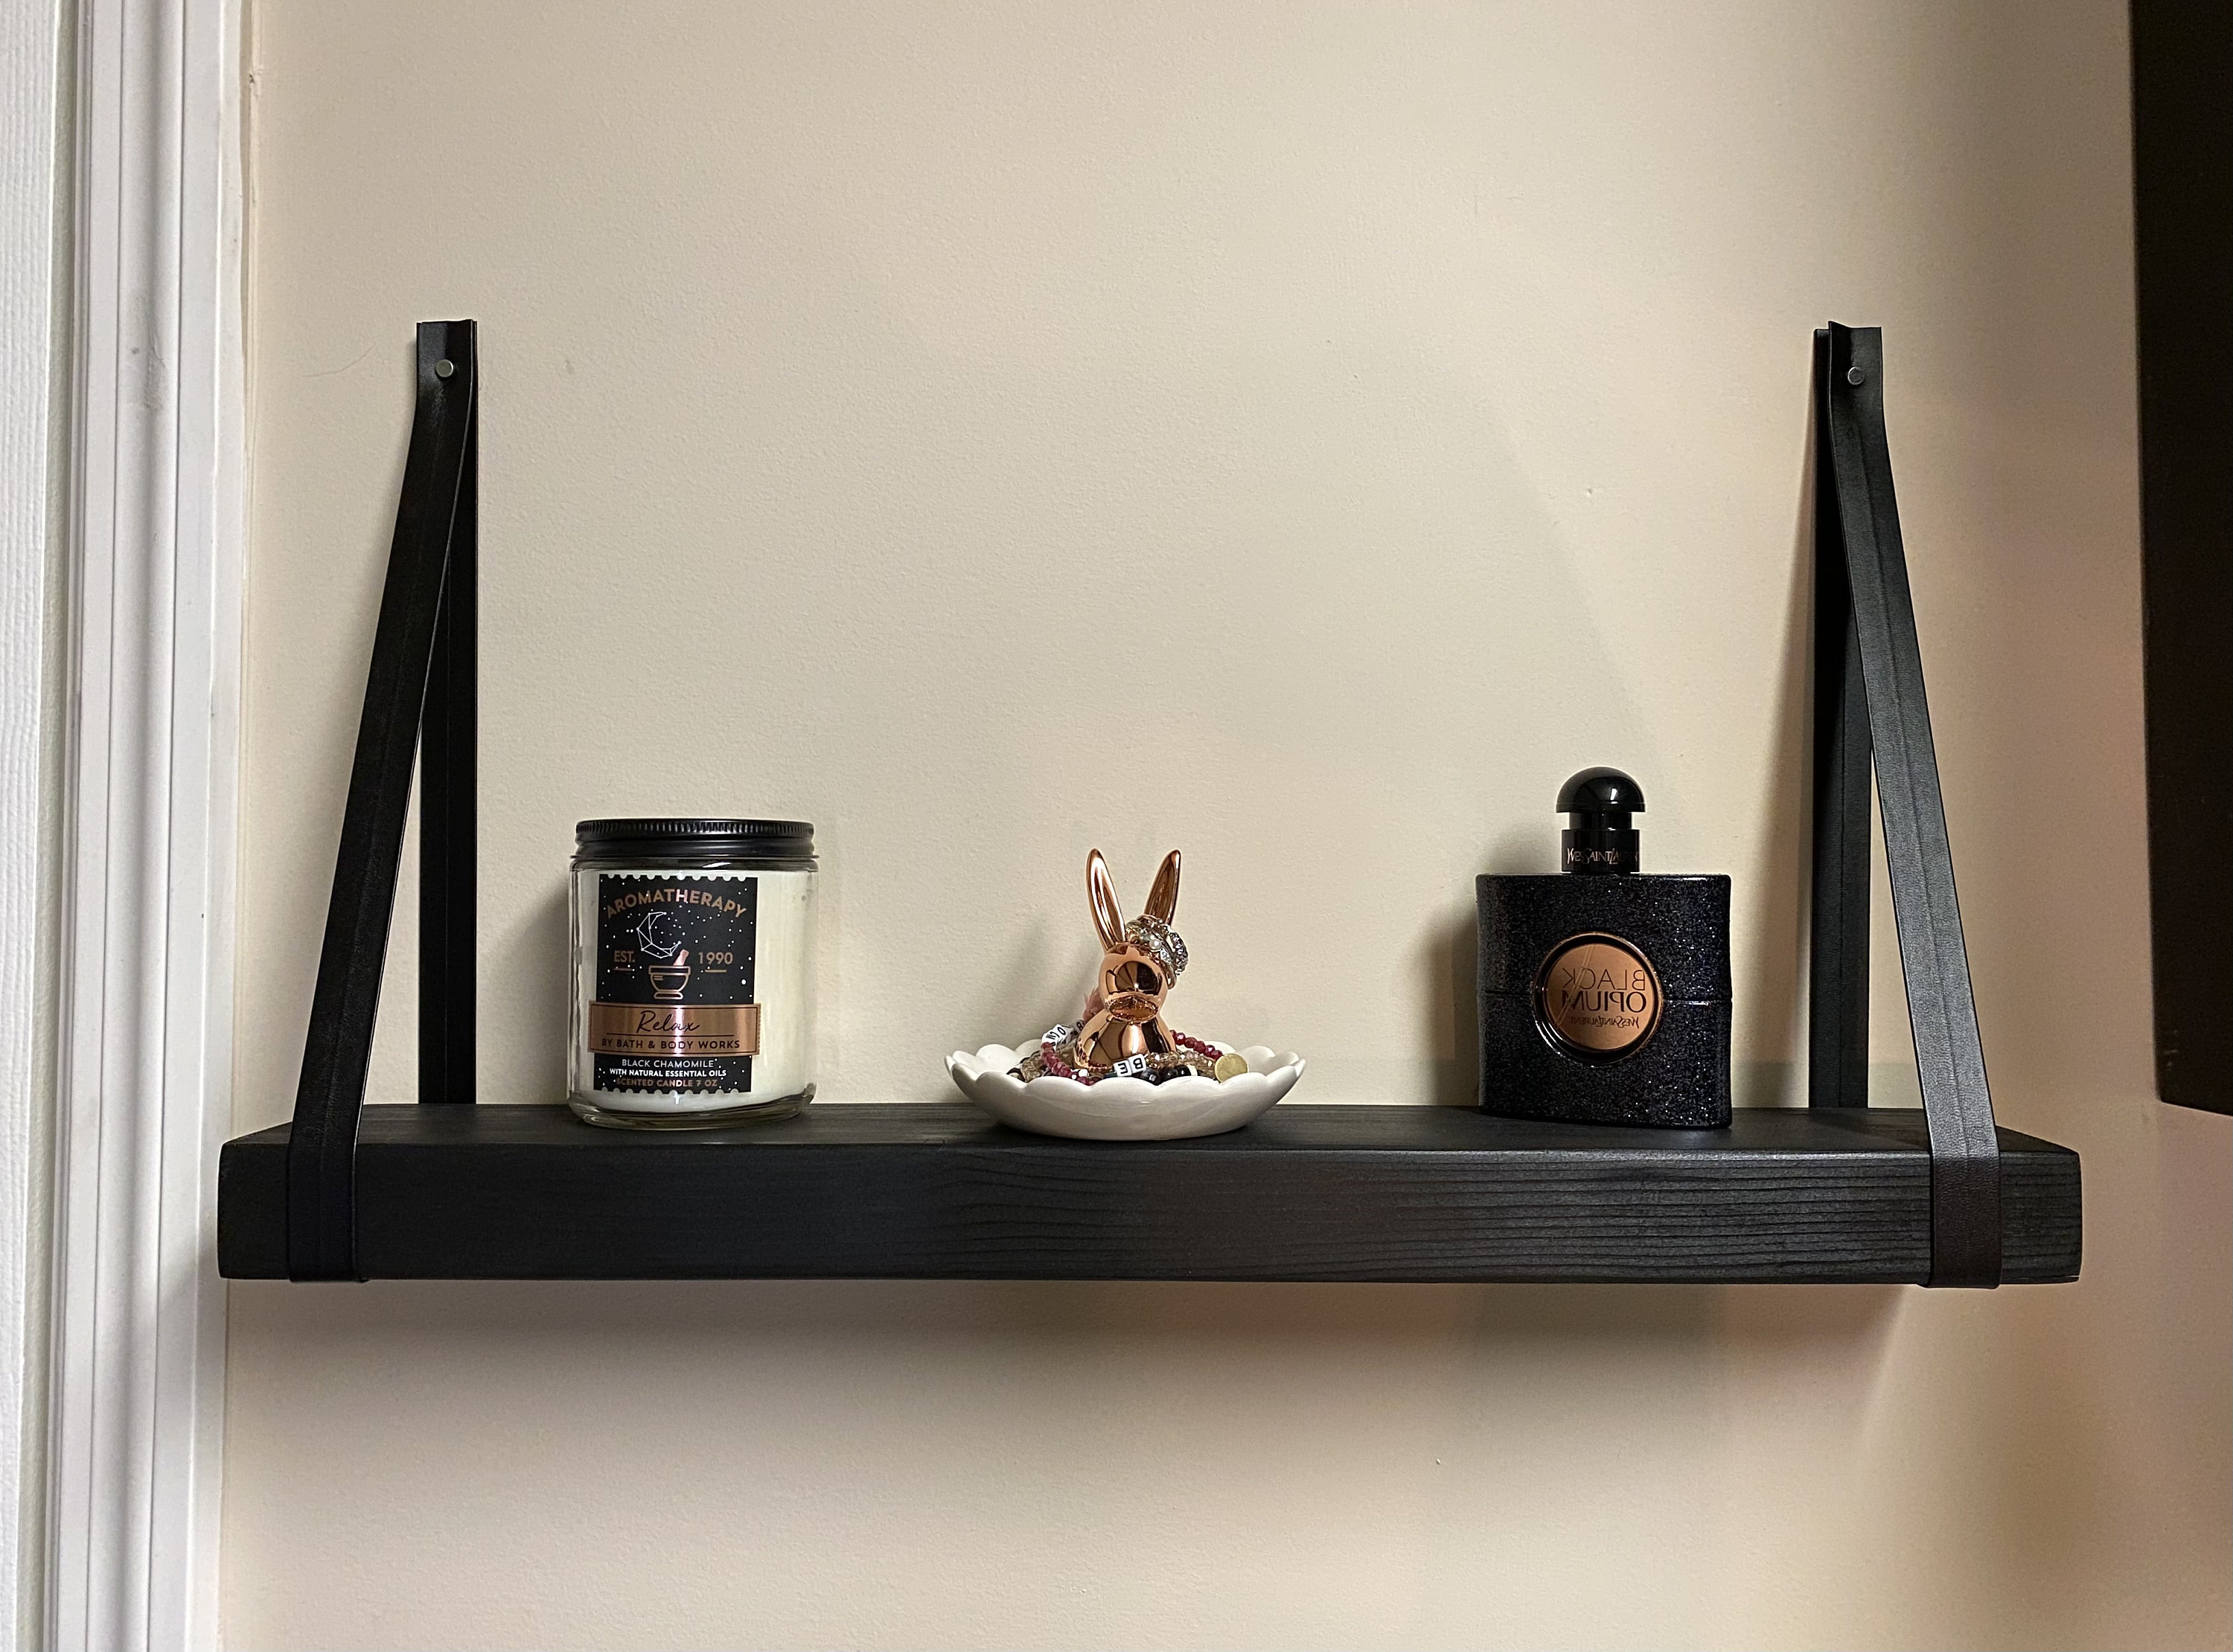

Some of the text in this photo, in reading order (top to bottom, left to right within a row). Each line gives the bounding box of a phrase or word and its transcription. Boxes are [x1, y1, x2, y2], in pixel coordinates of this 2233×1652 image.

[607, 889, 747, 919] AROMATHERAPY
[613, 950, 636, 963] EST.
[698, 952, 734, 964] 1990
[636, 1010, 701, 1034] Relax
[601, 1038, 741, 1049] BY BATH & BODY WORKS
[622, 1059, 715, 1069] BLACK CHAMOMILE
[610, 1068, 727, 1078] WITH NATURAL ESSENTIAL OILS
[616, 1078, 718, 1087] SCENTED CANDLE 7 OZ
